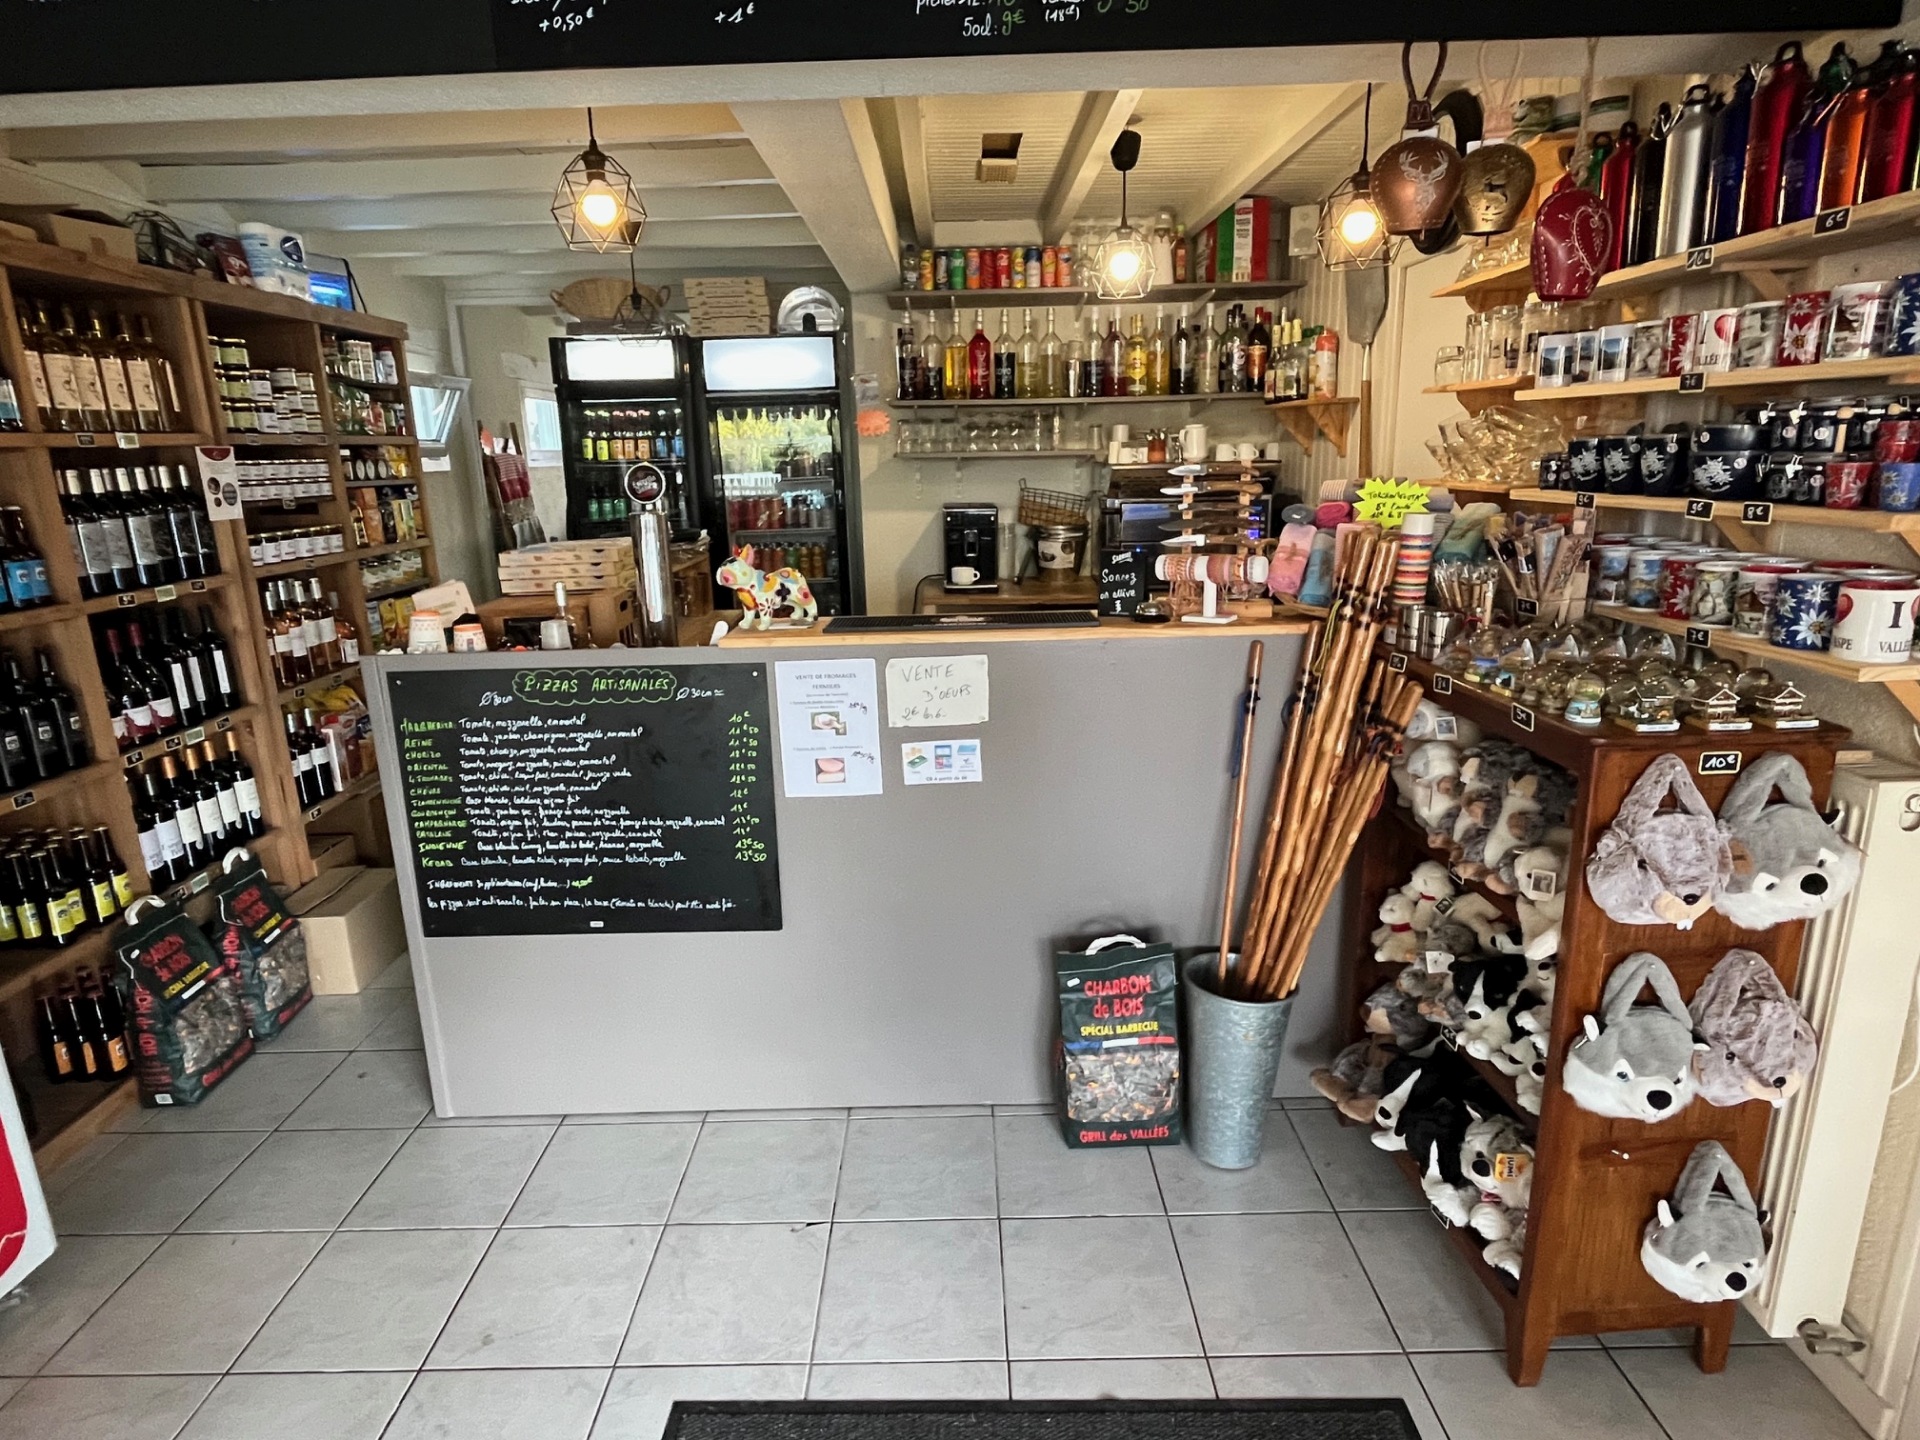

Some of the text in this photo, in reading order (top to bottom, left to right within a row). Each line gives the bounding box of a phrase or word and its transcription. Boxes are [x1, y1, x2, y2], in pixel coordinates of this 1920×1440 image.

[1825, 212, 1845, 227] 6€
[1690, 502, 1704, 513] 9€
[1747, 505, 1763, 519] 8€
[1888, 601, 1906, 629] I
[1689, 629, 1705, 642] 7€
[1879, 639, 1912, 653] VALLÉ
[901, 663, 955, 683] VENTE
[524, 674, 670, 693] PIZZAS ARTISANALES
[404, 738, 434, 749] REINE
[1704, 753, 1735, 769] 10€
[735, 838, 765, 850] 13€50
[735, 850, 767, 862] 13€50
[1084, 974, 1153, 997] CHARBON
[1093, 998, 1143, 1018] de BOIS
[1116, 1021, 1159, 1035] BARBECUE
[1079, 1125, 1169, 1143] GRILL des VALLÉES
